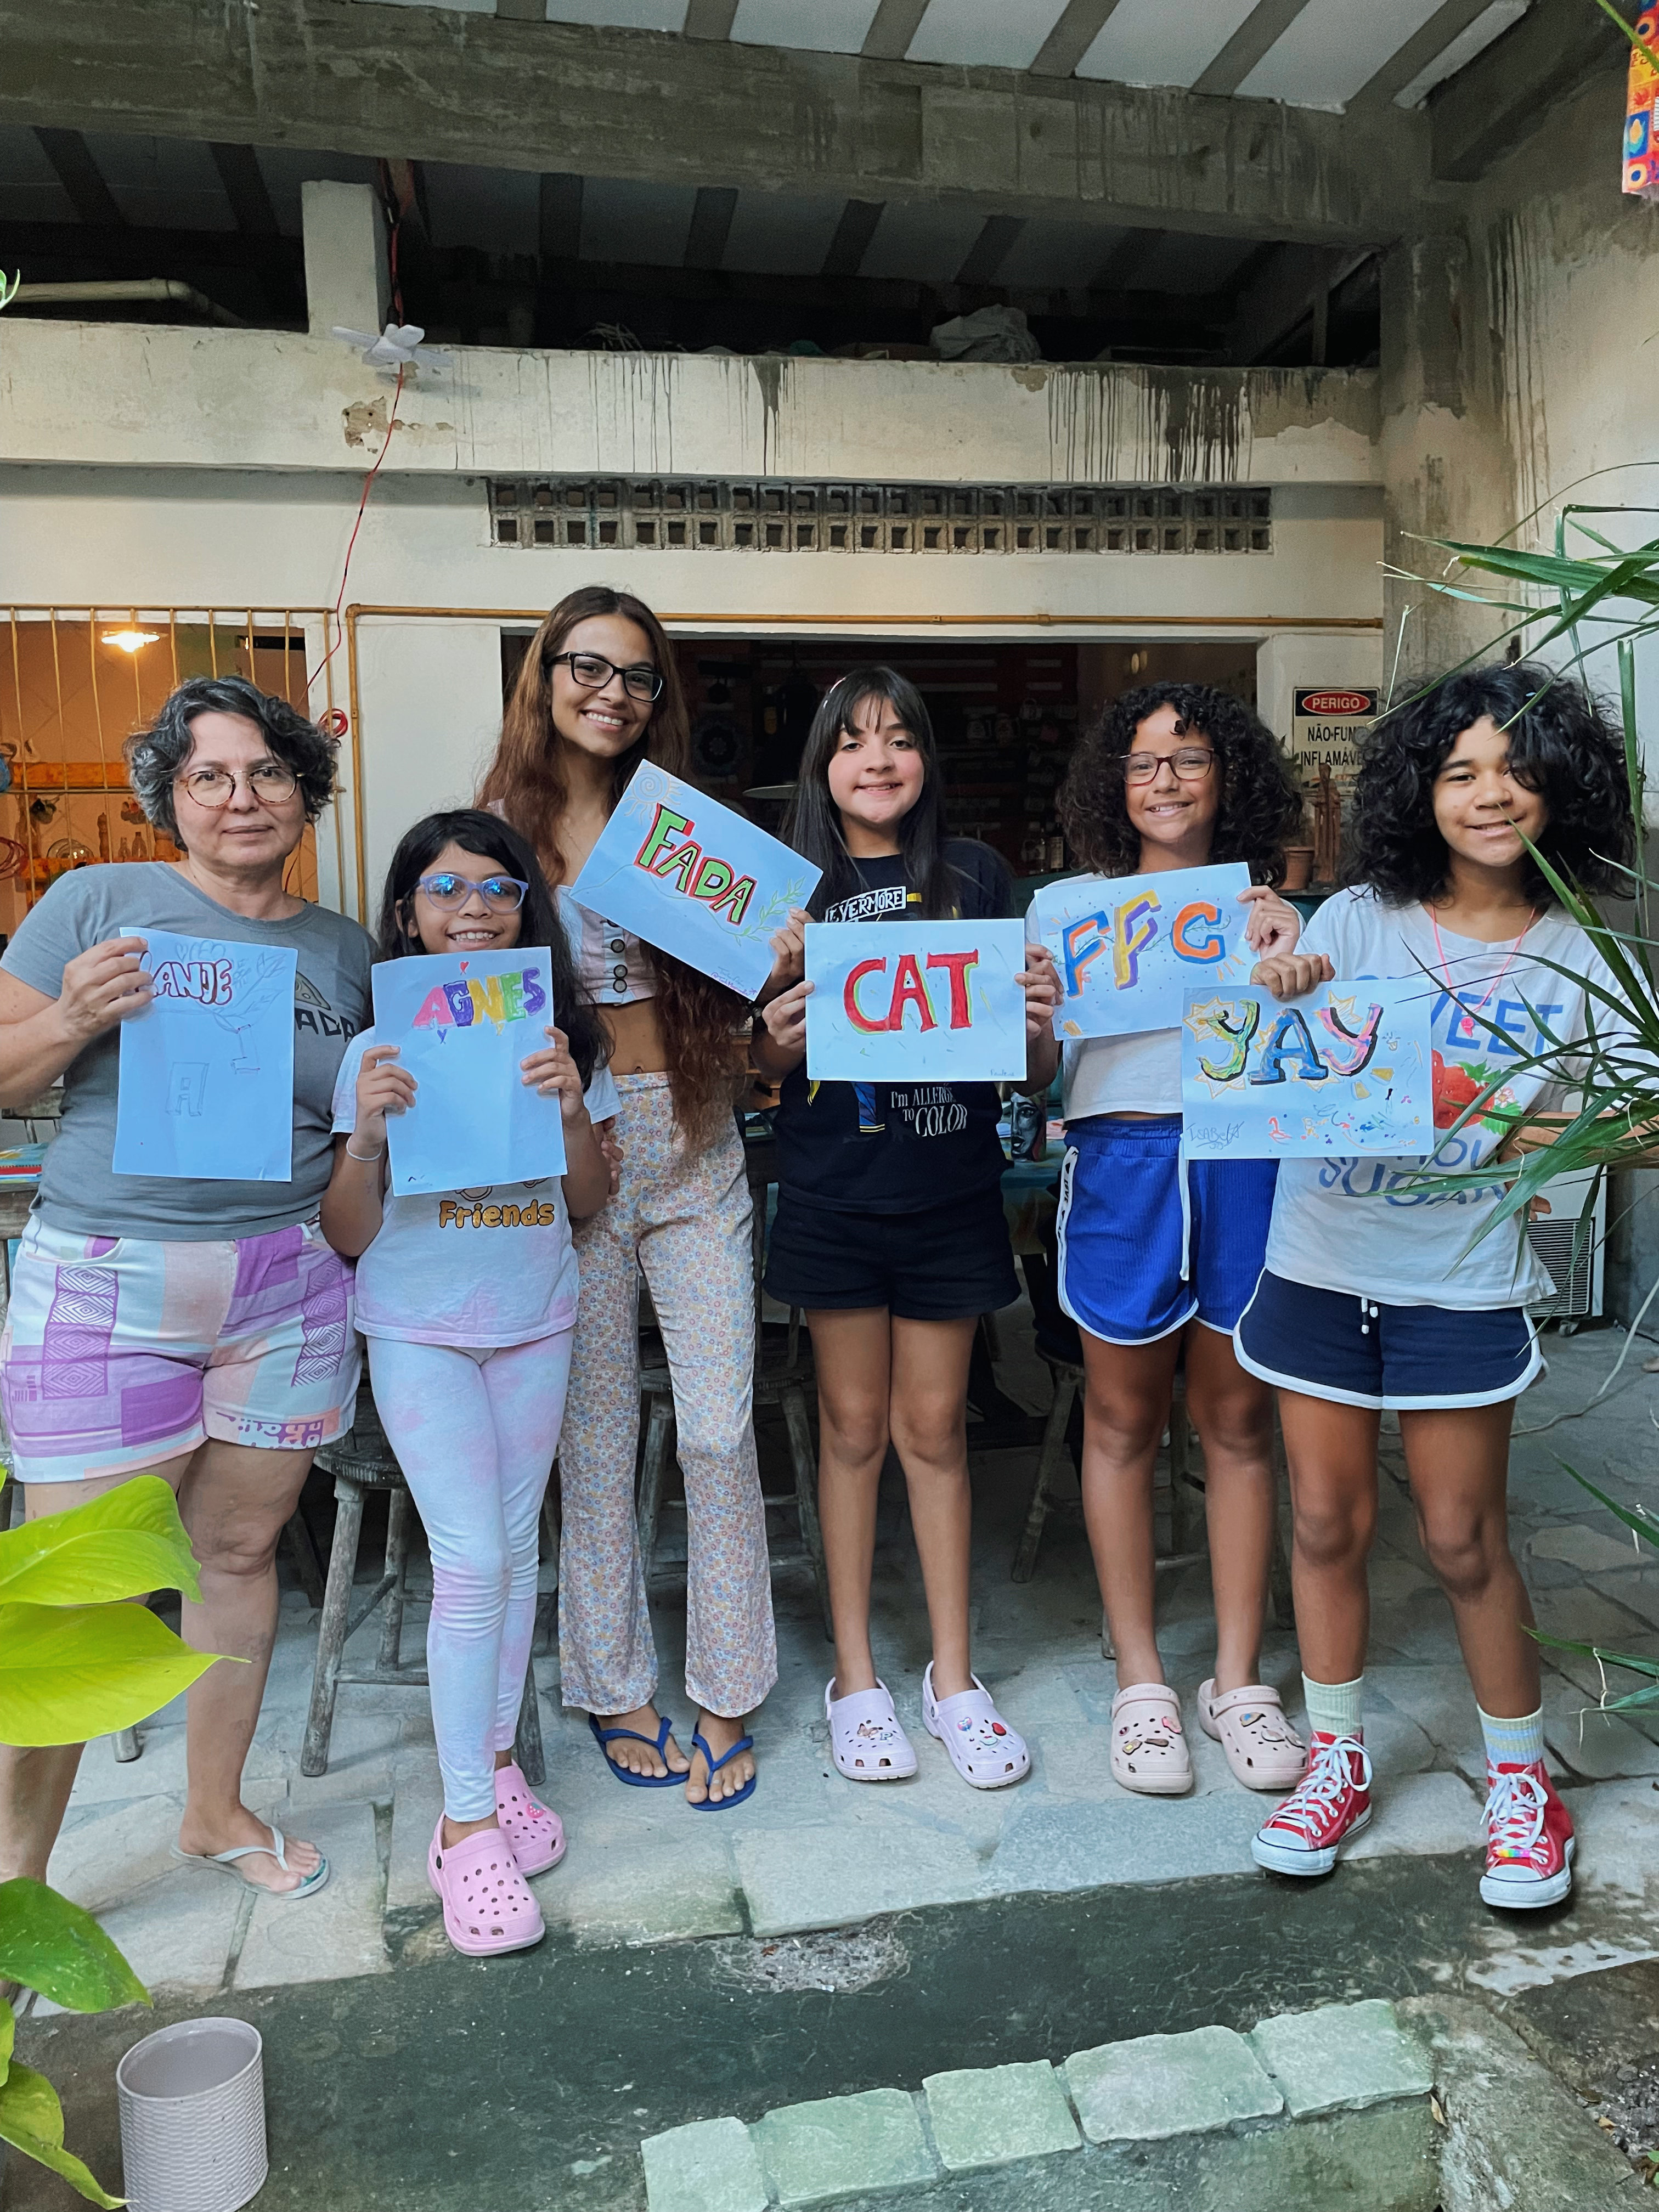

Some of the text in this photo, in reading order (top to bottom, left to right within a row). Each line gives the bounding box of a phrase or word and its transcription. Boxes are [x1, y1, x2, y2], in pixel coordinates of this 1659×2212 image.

[1312, 697, 1360, 709] PERIGO
[1301, 747, 1362, 766] INFLAMÁVE
[634, 803, 757, 926] FADA
[829, 890, 901, 922] EVERMORE
[411, 967, 546, 1030] AGNES
[843, 949, 979, 1035] CAT
[1431, 991, 1563, 1057] EET
[1196, 999, 1384, 1085] YAY
[891, 1091, 908, 1108] I'm
[902, 1104, 967, 1137] TO COLOR
[439, 1199, 554, 1228] Friends
